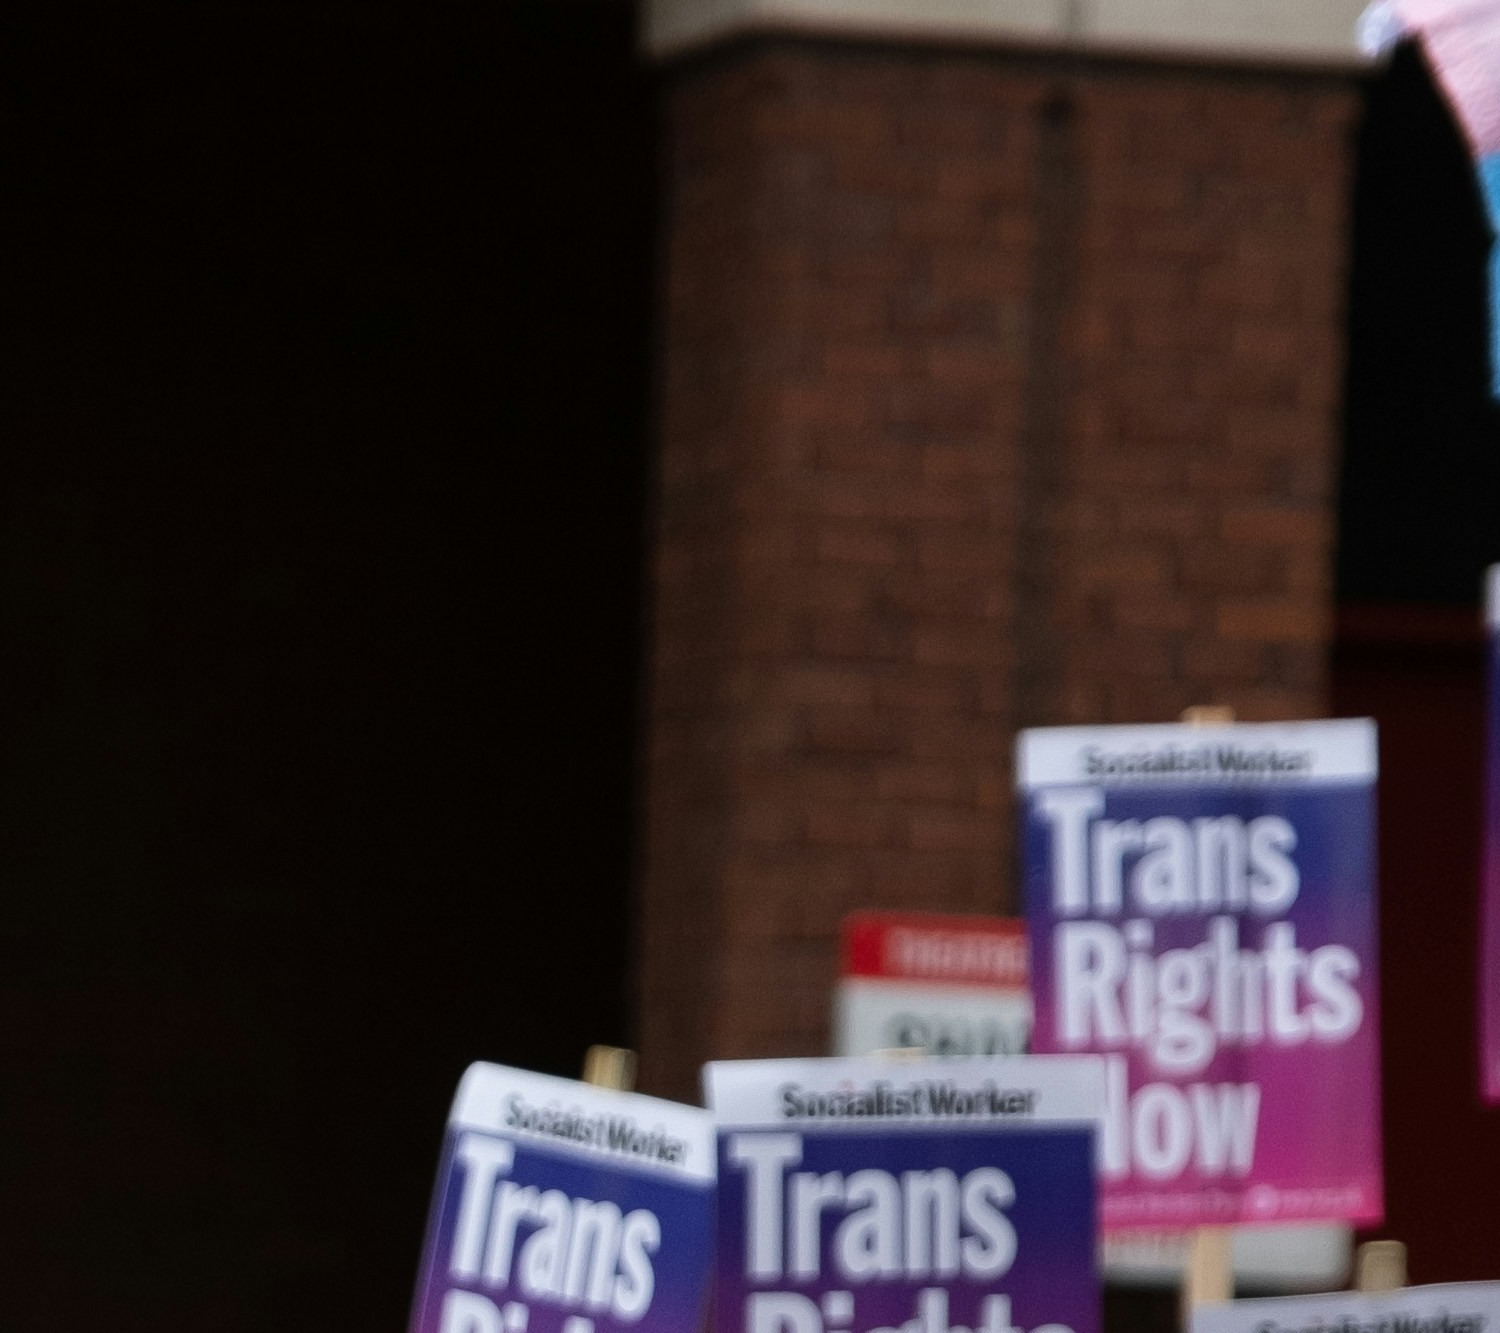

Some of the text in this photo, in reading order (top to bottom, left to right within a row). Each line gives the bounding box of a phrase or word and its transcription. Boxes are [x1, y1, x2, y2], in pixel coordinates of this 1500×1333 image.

[1034, 784, 1299, 914] Trans
[1053, 914, 1364, 1074] Rights
[453, 1136, 661, 1320] Trans
[728, 1131, 1018, 1280] Trans
